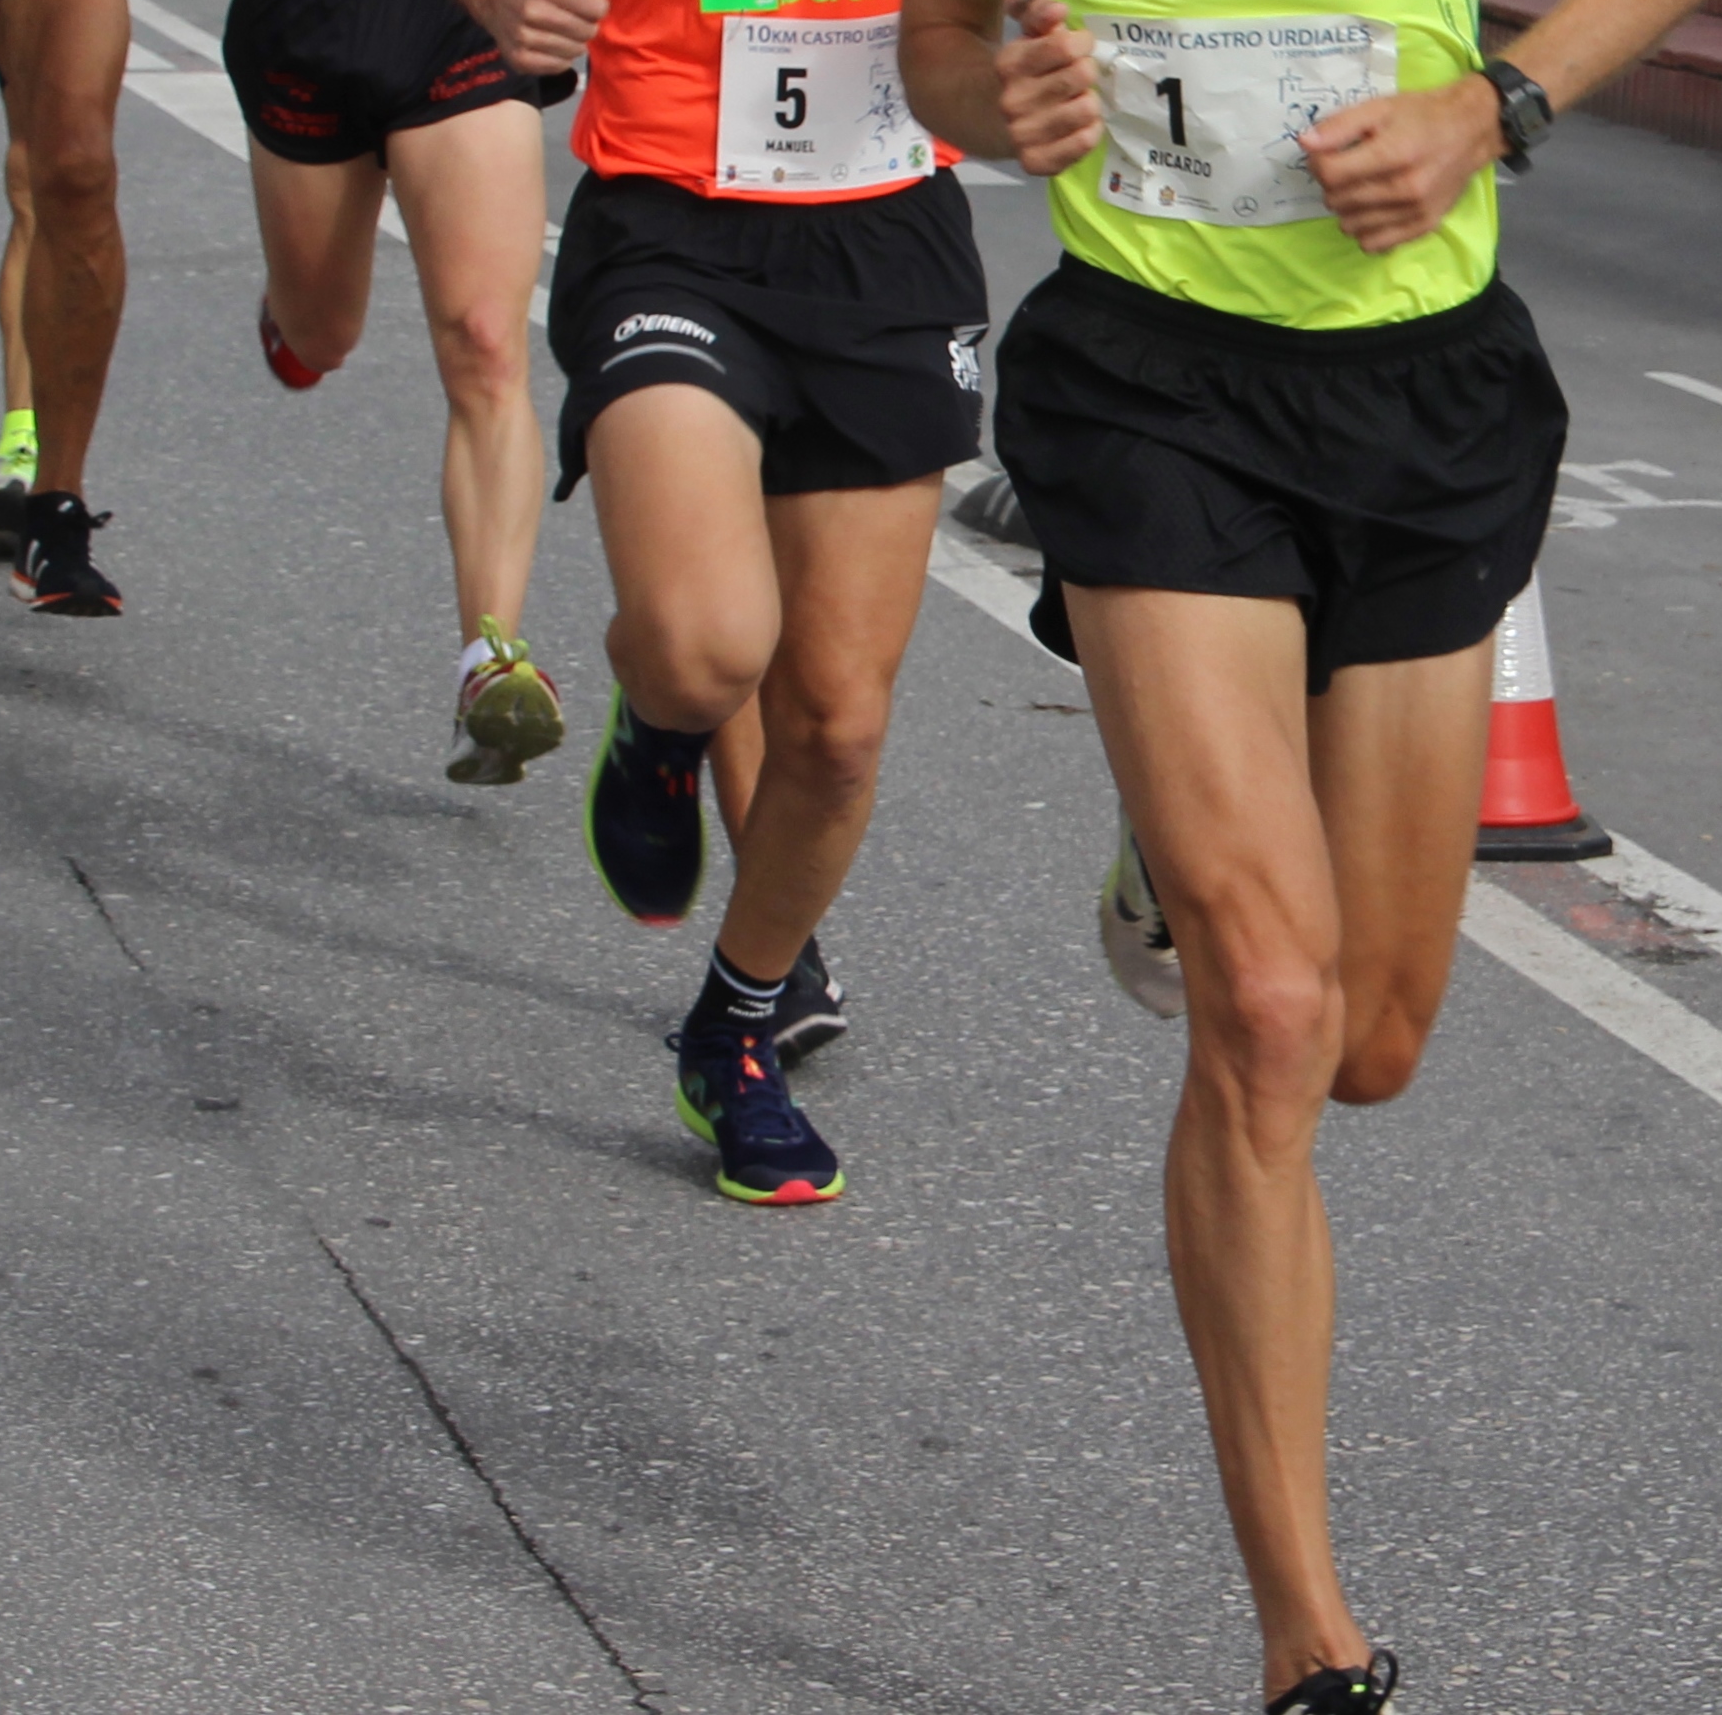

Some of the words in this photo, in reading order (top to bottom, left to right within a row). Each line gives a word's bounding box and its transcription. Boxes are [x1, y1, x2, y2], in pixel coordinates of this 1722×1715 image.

[745, 24, 797, 44] 10KM
[801, 30, 864, 45] CASTRO
[1110, 23, 1174, 48] 10KM
[1178, 31, 1263, 50] CASTRO
[1267, 23, 1371, 48] URDIALES
[774, 67, 808, 130] 5
[1156, 77, 1187, 147] 1
[765, 139, 816, 153] MANUEL
[1149, 149, 1212, 178] RICARDO
